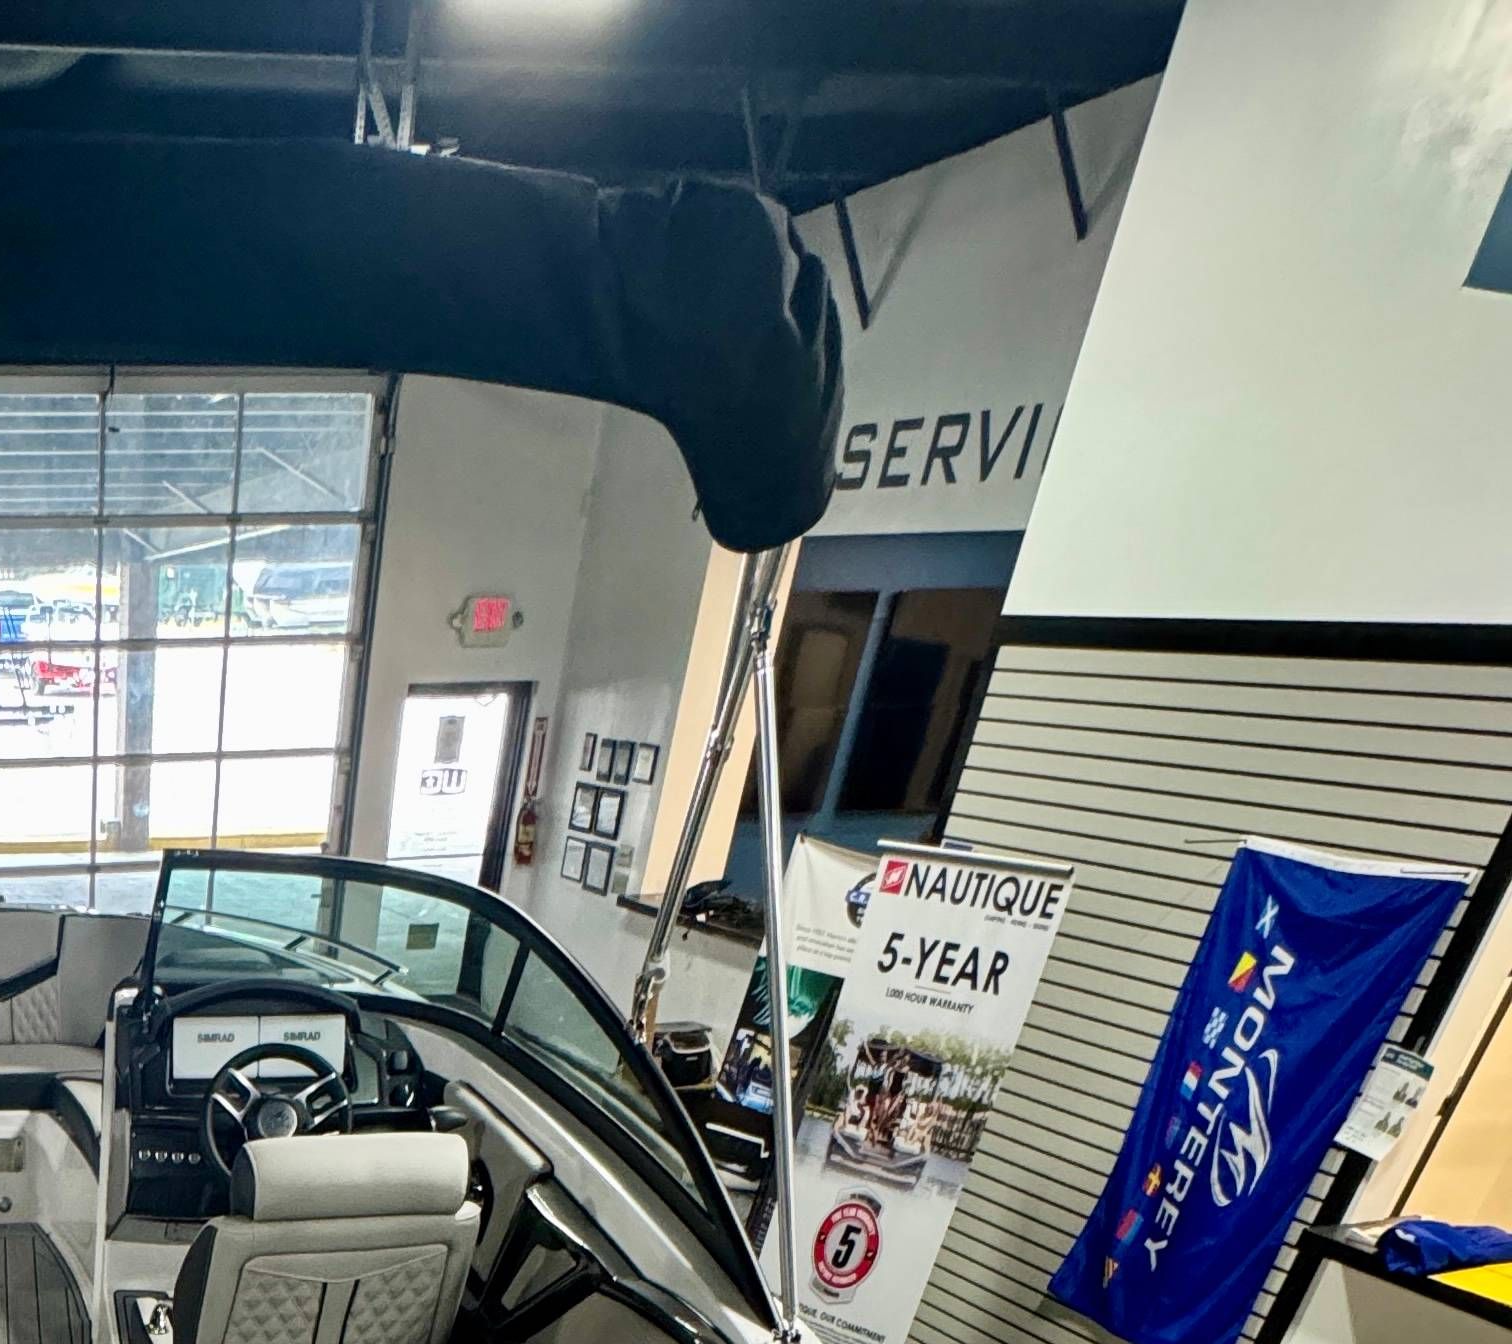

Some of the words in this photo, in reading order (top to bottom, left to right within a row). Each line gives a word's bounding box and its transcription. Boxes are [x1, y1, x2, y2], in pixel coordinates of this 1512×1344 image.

[835, 403, 1065, 491] SERVI
[904, 863, 1064, 921] NAUTIQUE
[877, 932, 1009, 996] 5-YEAR
[904, 992, 928, 1005] HOUR
[929, 997, 974, 1015] WARRANTY
[197, 1033, 235, 1043] SIMRAD
[284, 1031, 321, 1041] SIMRAD
[1144, 945, 1296, 1273] MONTEREY
[831, 1224, 862, 1269] 5
[836, 1318, 886, 1344] COMMITMENT
